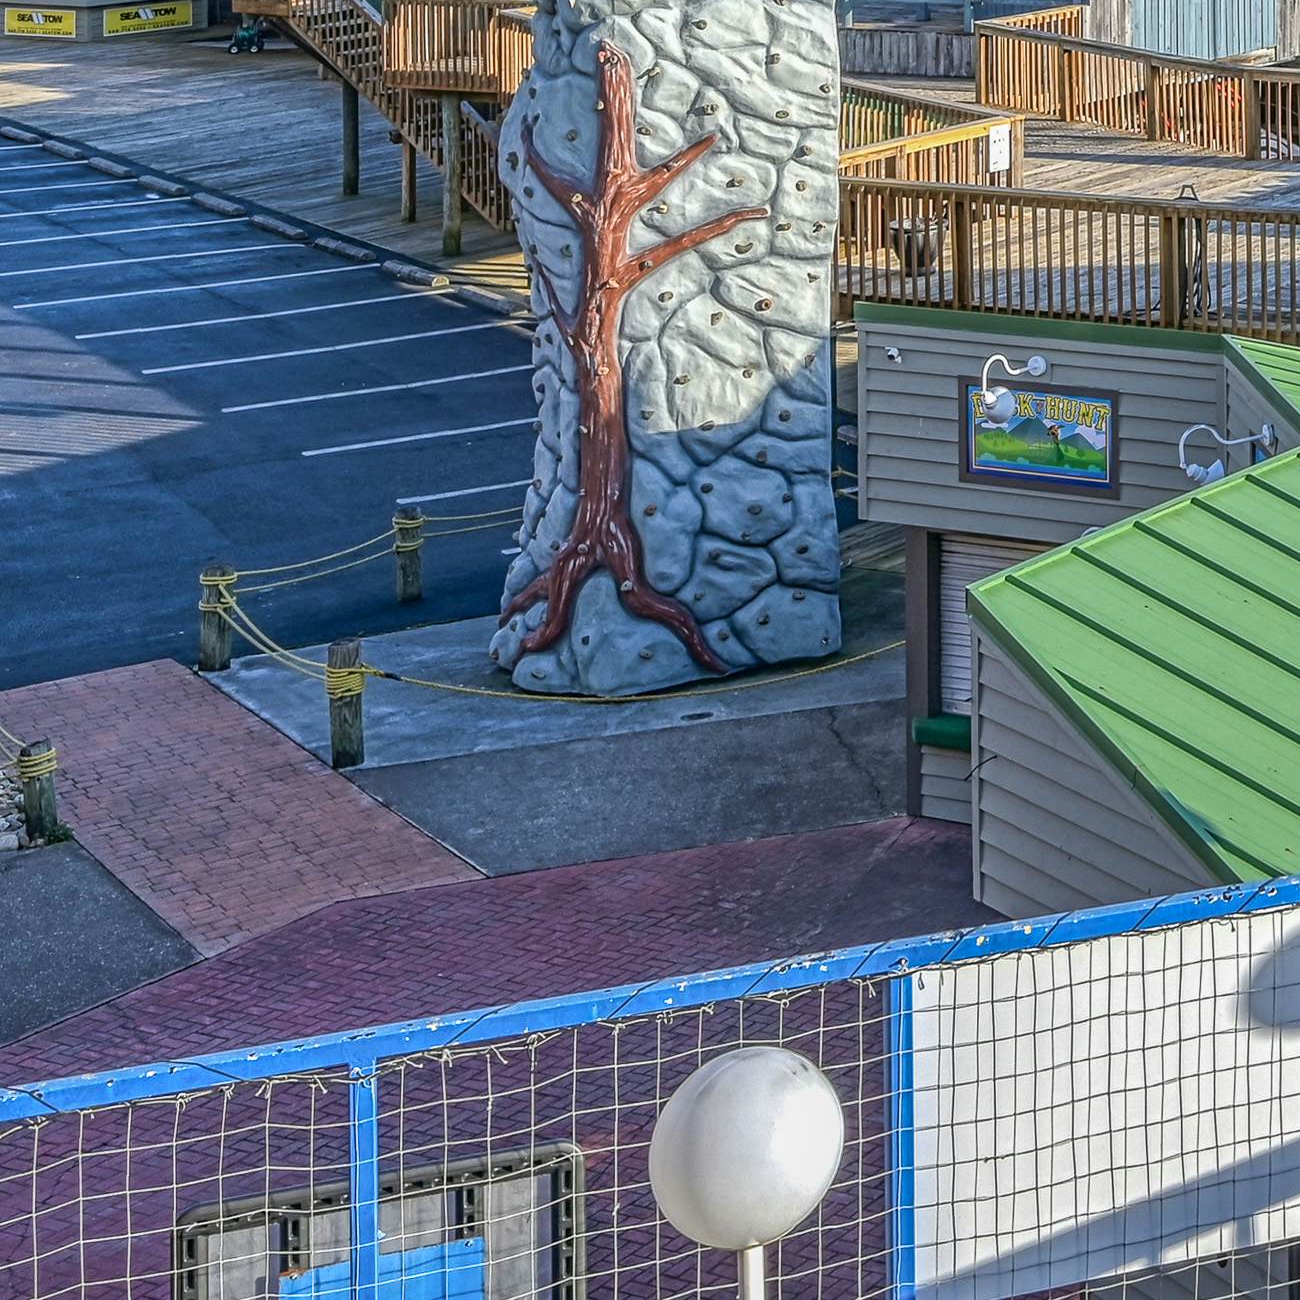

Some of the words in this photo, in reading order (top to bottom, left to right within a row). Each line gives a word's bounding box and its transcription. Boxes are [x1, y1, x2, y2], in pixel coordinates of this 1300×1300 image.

[17, 13, 33, 22] SEA
[42, 15, 63, 23] TOW
[120, 12, 141, 21] SEA
[152, 7, 176, 17] TOW
[971, 391, 1036, 419] DK
[1045, 395, 1111, 431] HUNT
